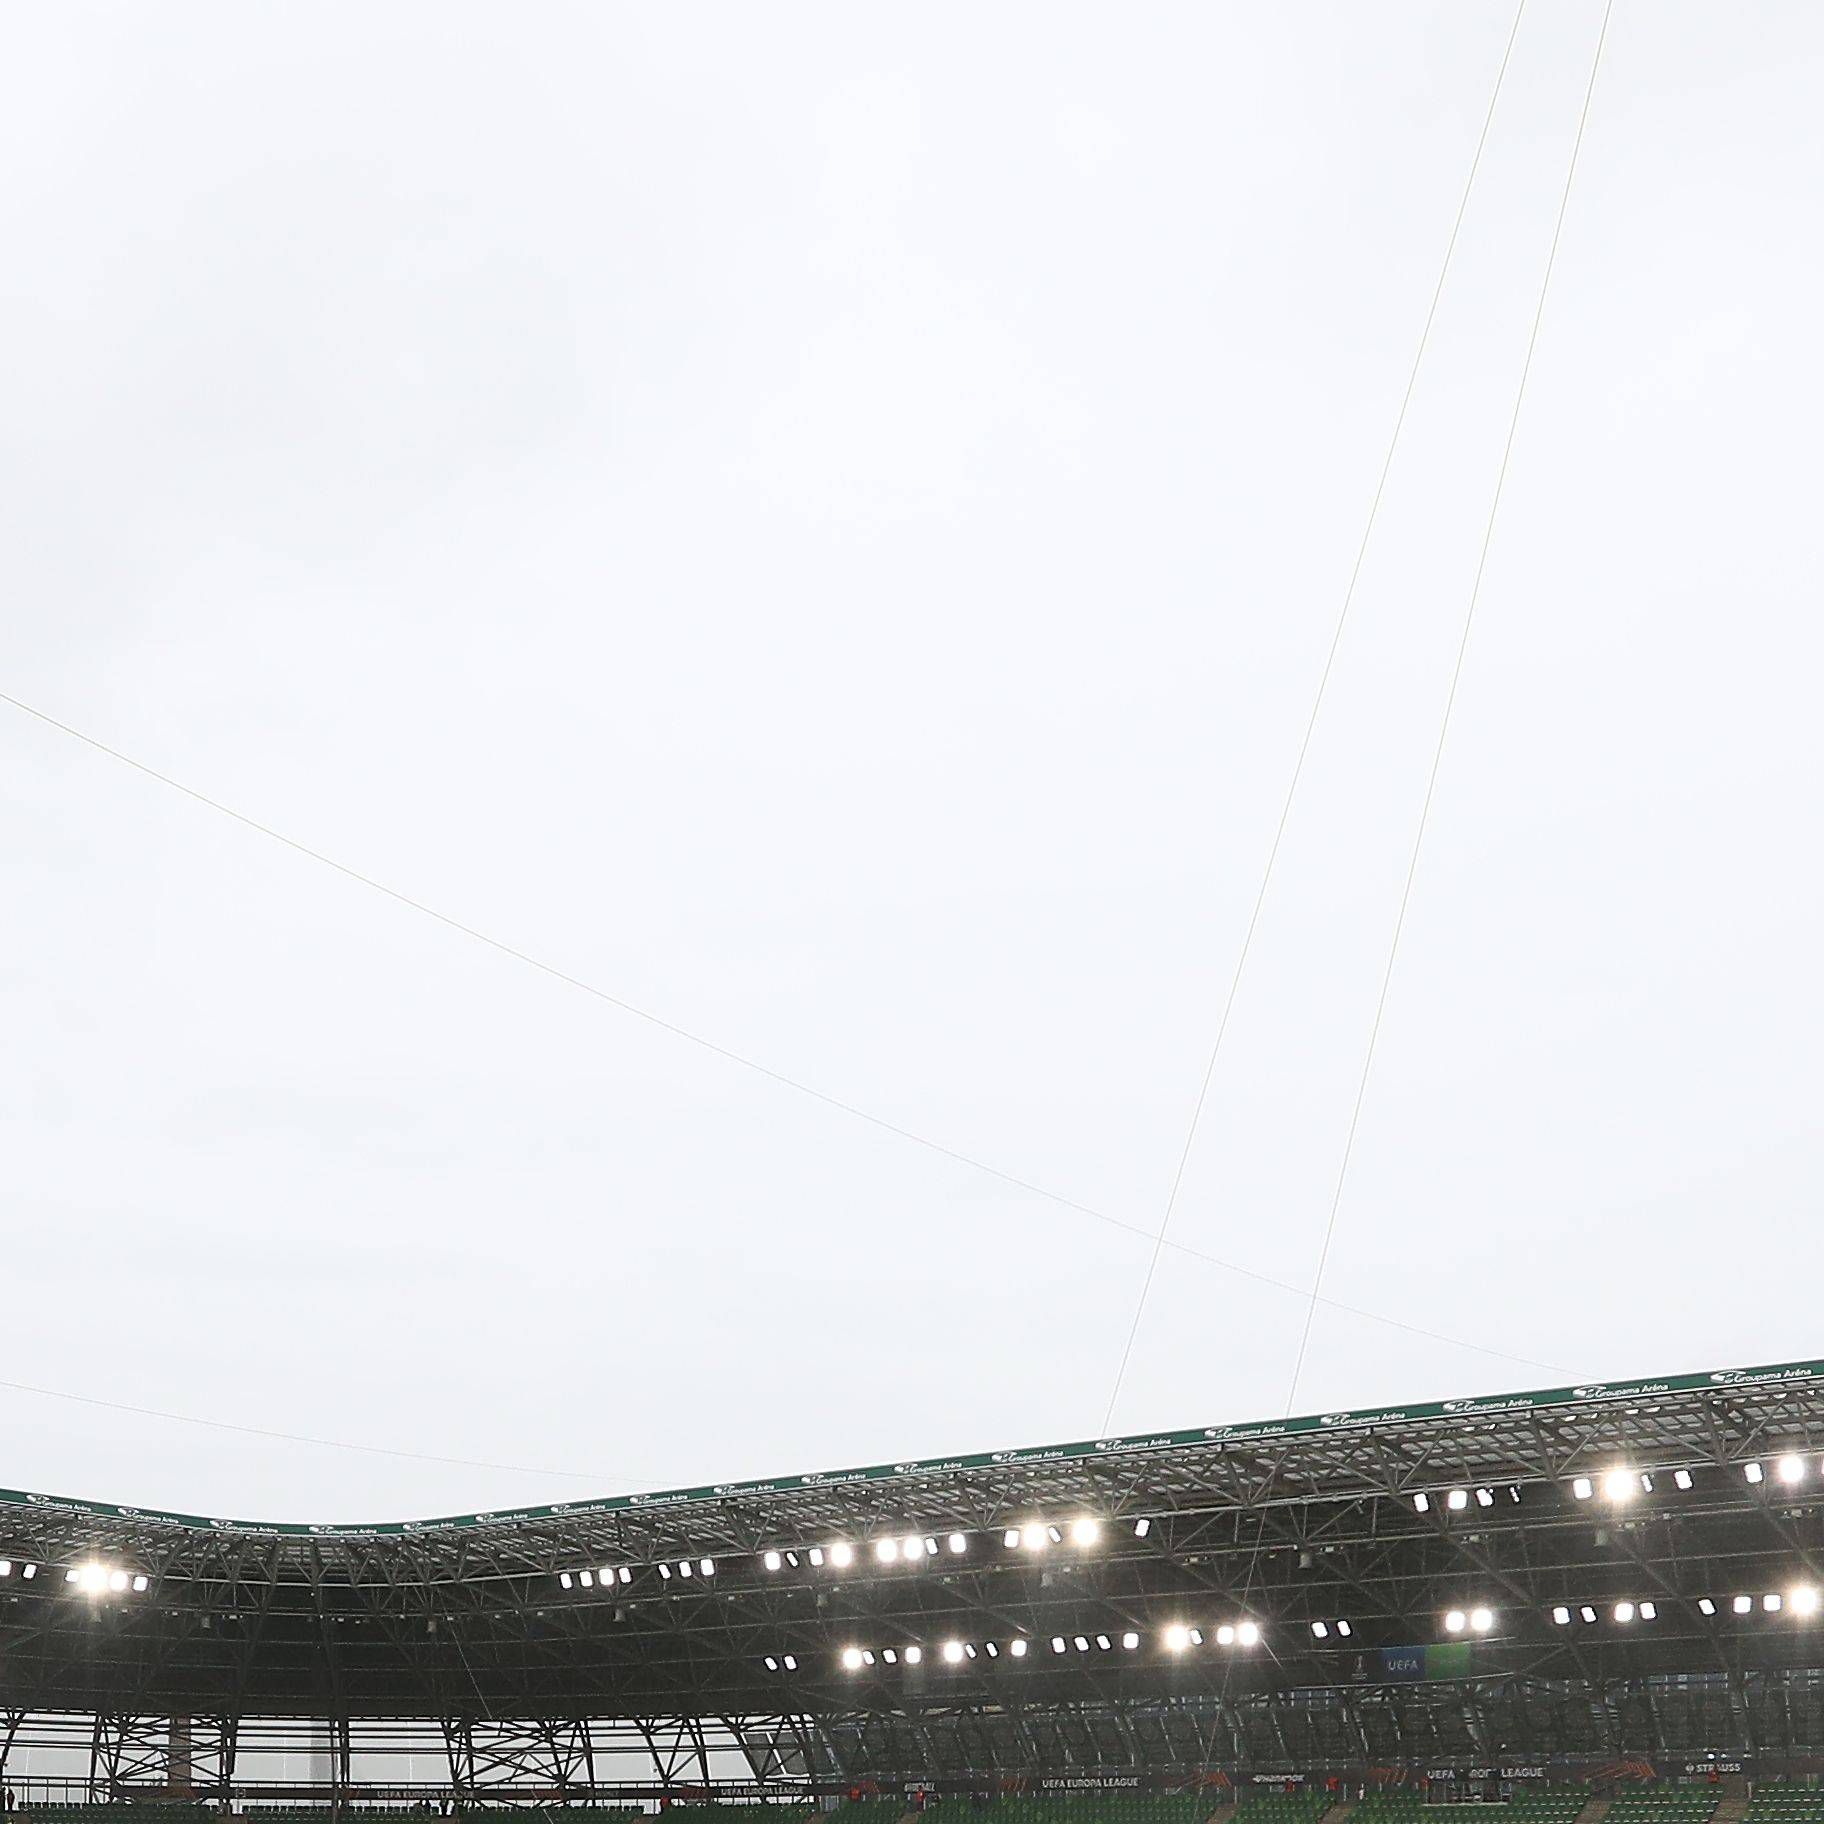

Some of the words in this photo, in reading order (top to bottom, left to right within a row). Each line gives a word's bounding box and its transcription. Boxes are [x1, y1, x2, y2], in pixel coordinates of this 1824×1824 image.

[1737, 1370, 1781, 1383] Groupama
[1596, 1387, 1639, 1399] Groupama
[1467, 1401, 1507, 1413] Groupama
[1388, 1660, 1418, 1671] UEFA
[1427, 1769, 1455, 1780] UEFA
[1501, 1767, 1543, 1777] LEAGUE
[1042, 1779, 1065, 1788] UEFA
[1067, 1778, 1103, 1788] EUROPA
[1104, 1777, 1139, 1787] LEAGUE
